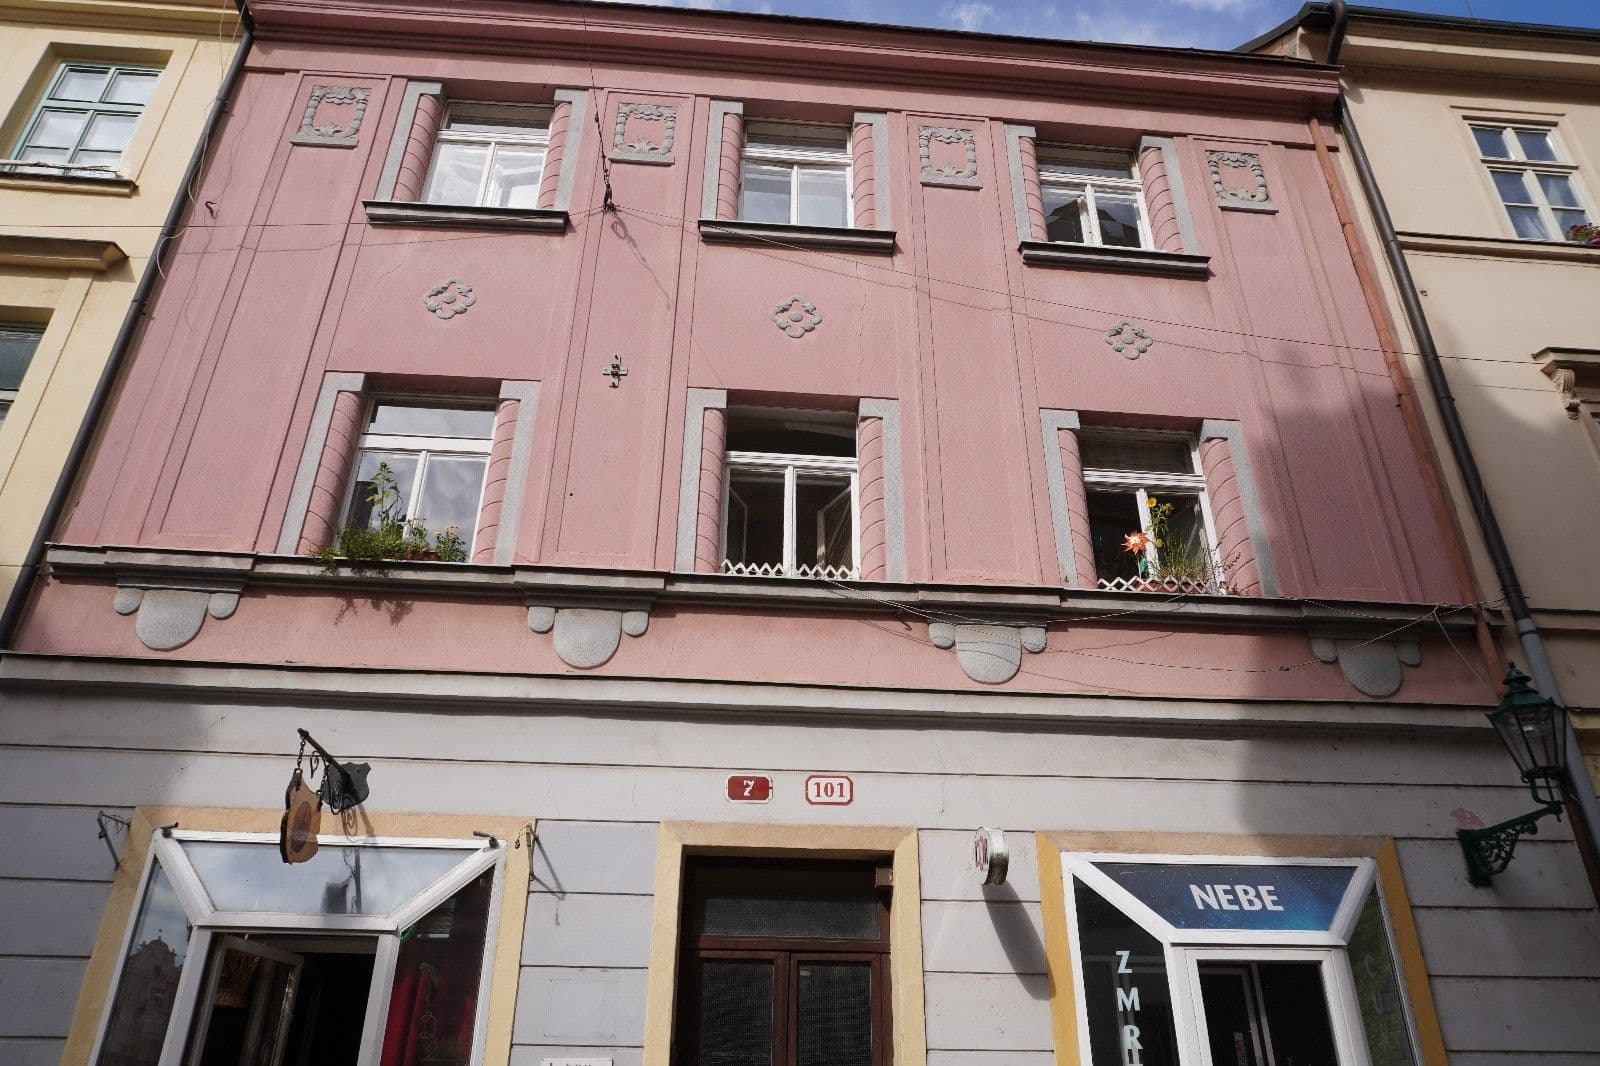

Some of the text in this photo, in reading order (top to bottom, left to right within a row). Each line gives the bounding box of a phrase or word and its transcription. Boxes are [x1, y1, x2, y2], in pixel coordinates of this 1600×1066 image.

[743, 780, 755, 797] 7
[813, 782, 846, 798] 101
[1189, 884, 1285, 911] NEBE
[1115, 950, 1144, 1066] ZMR
